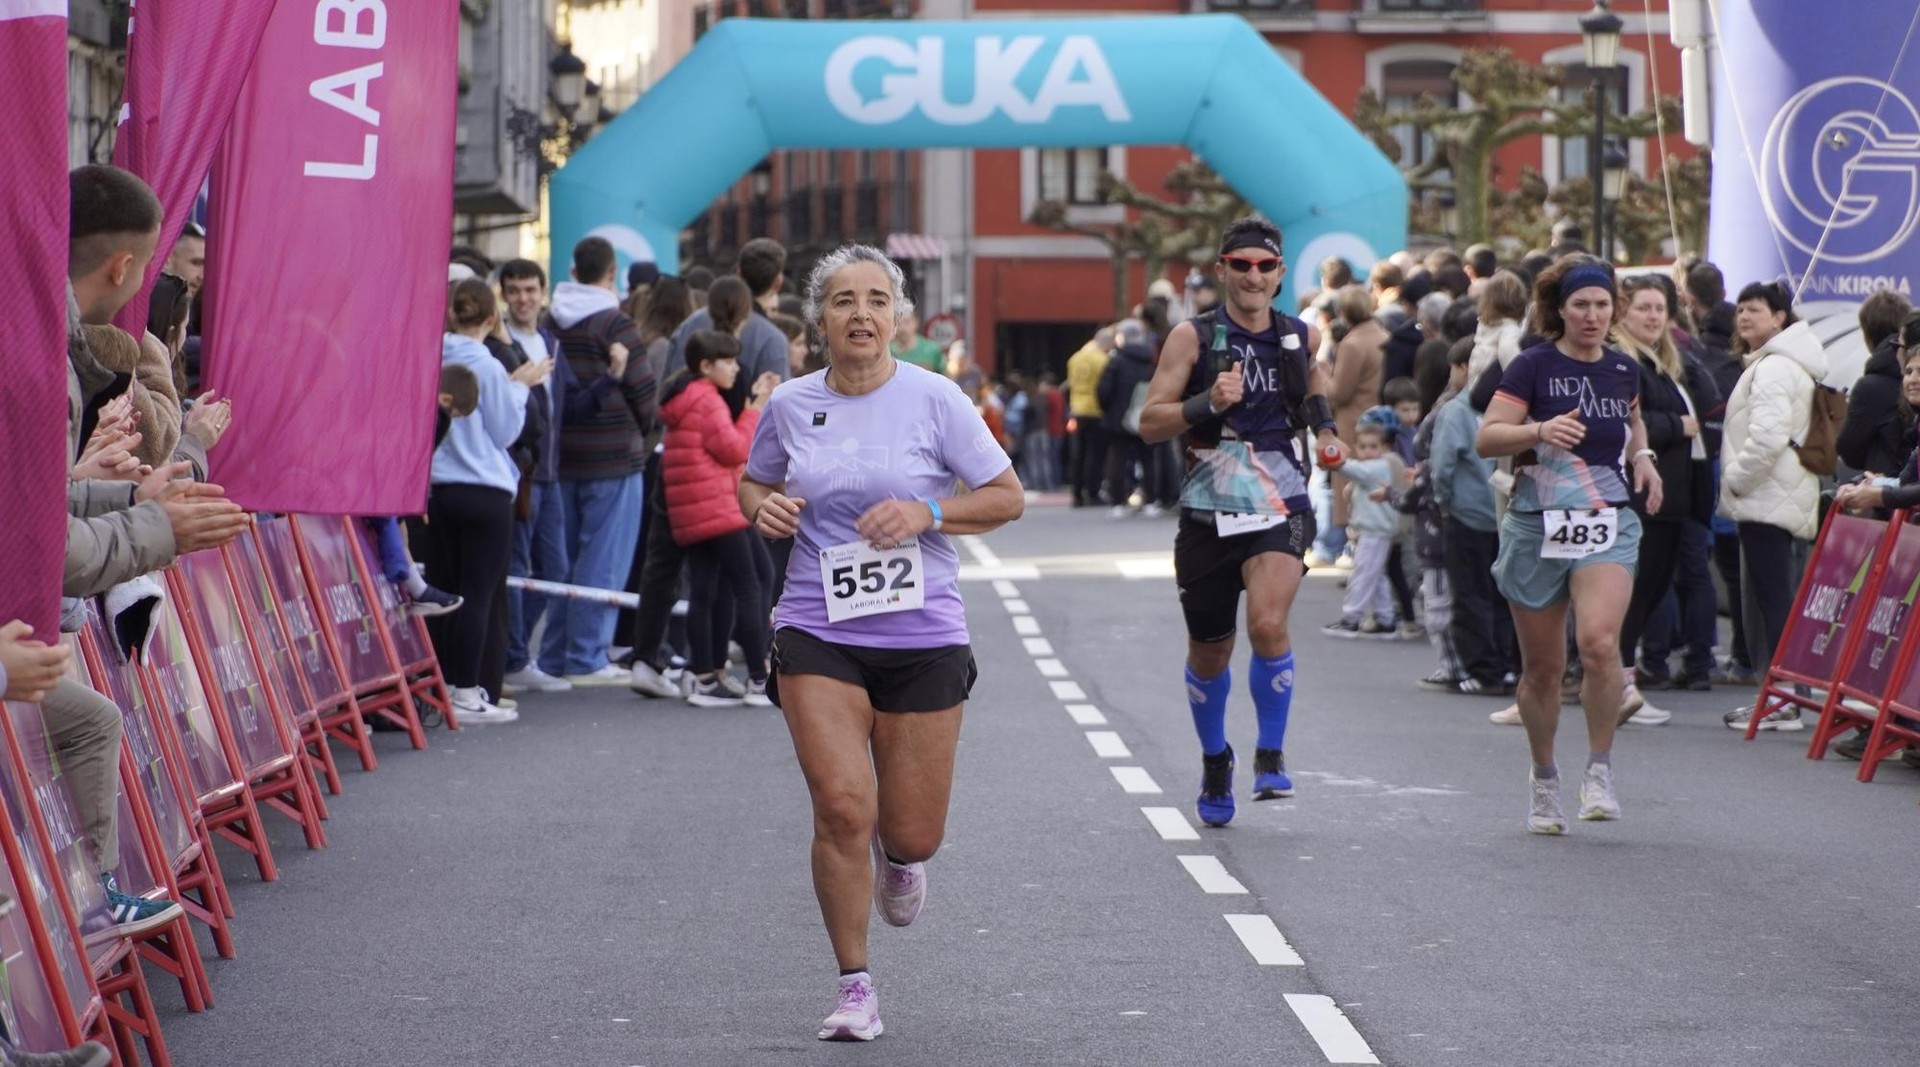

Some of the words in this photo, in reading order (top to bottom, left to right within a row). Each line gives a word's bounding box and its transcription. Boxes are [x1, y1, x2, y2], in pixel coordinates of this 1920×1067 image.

[824, 35, 1133, 125] GUKA
[1549, 523, 1609, 545] 483
[832, 557, 915, 600] 552
[850, 599, 885, 610] LABORAL
